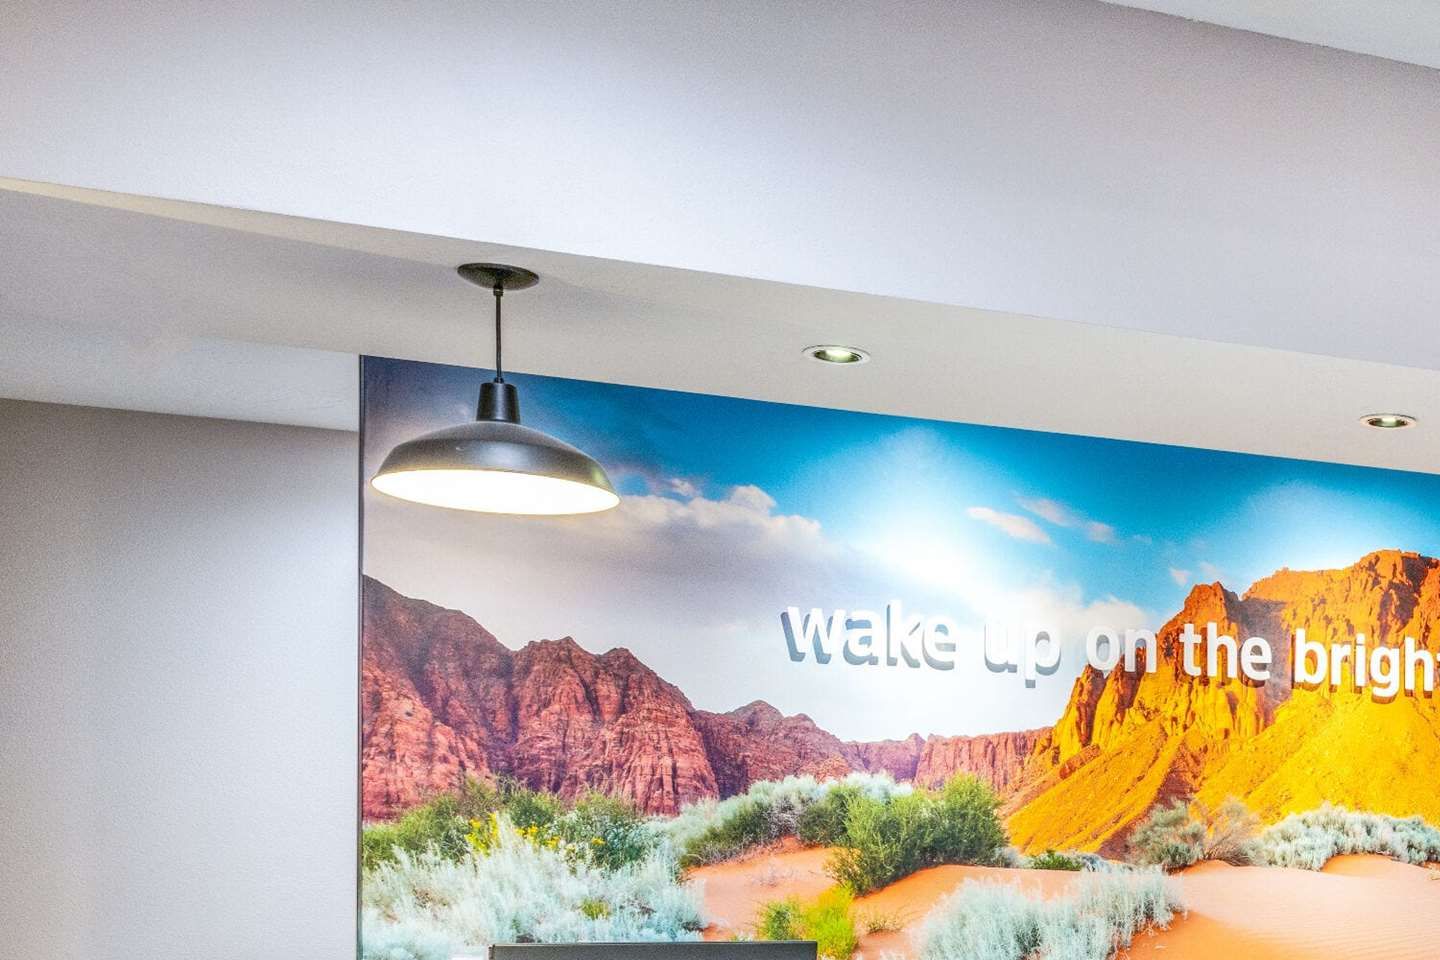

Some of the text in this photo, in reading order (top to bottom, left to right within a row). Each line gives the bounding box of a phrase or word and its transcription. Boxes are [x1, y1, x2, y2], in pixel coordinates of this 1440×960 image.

[786, 600, 959, 664] wake
[984, 622, 1061, 681] up
[1086, 626, 1157, 673] on
[1179, 622, 1272, 681] the
